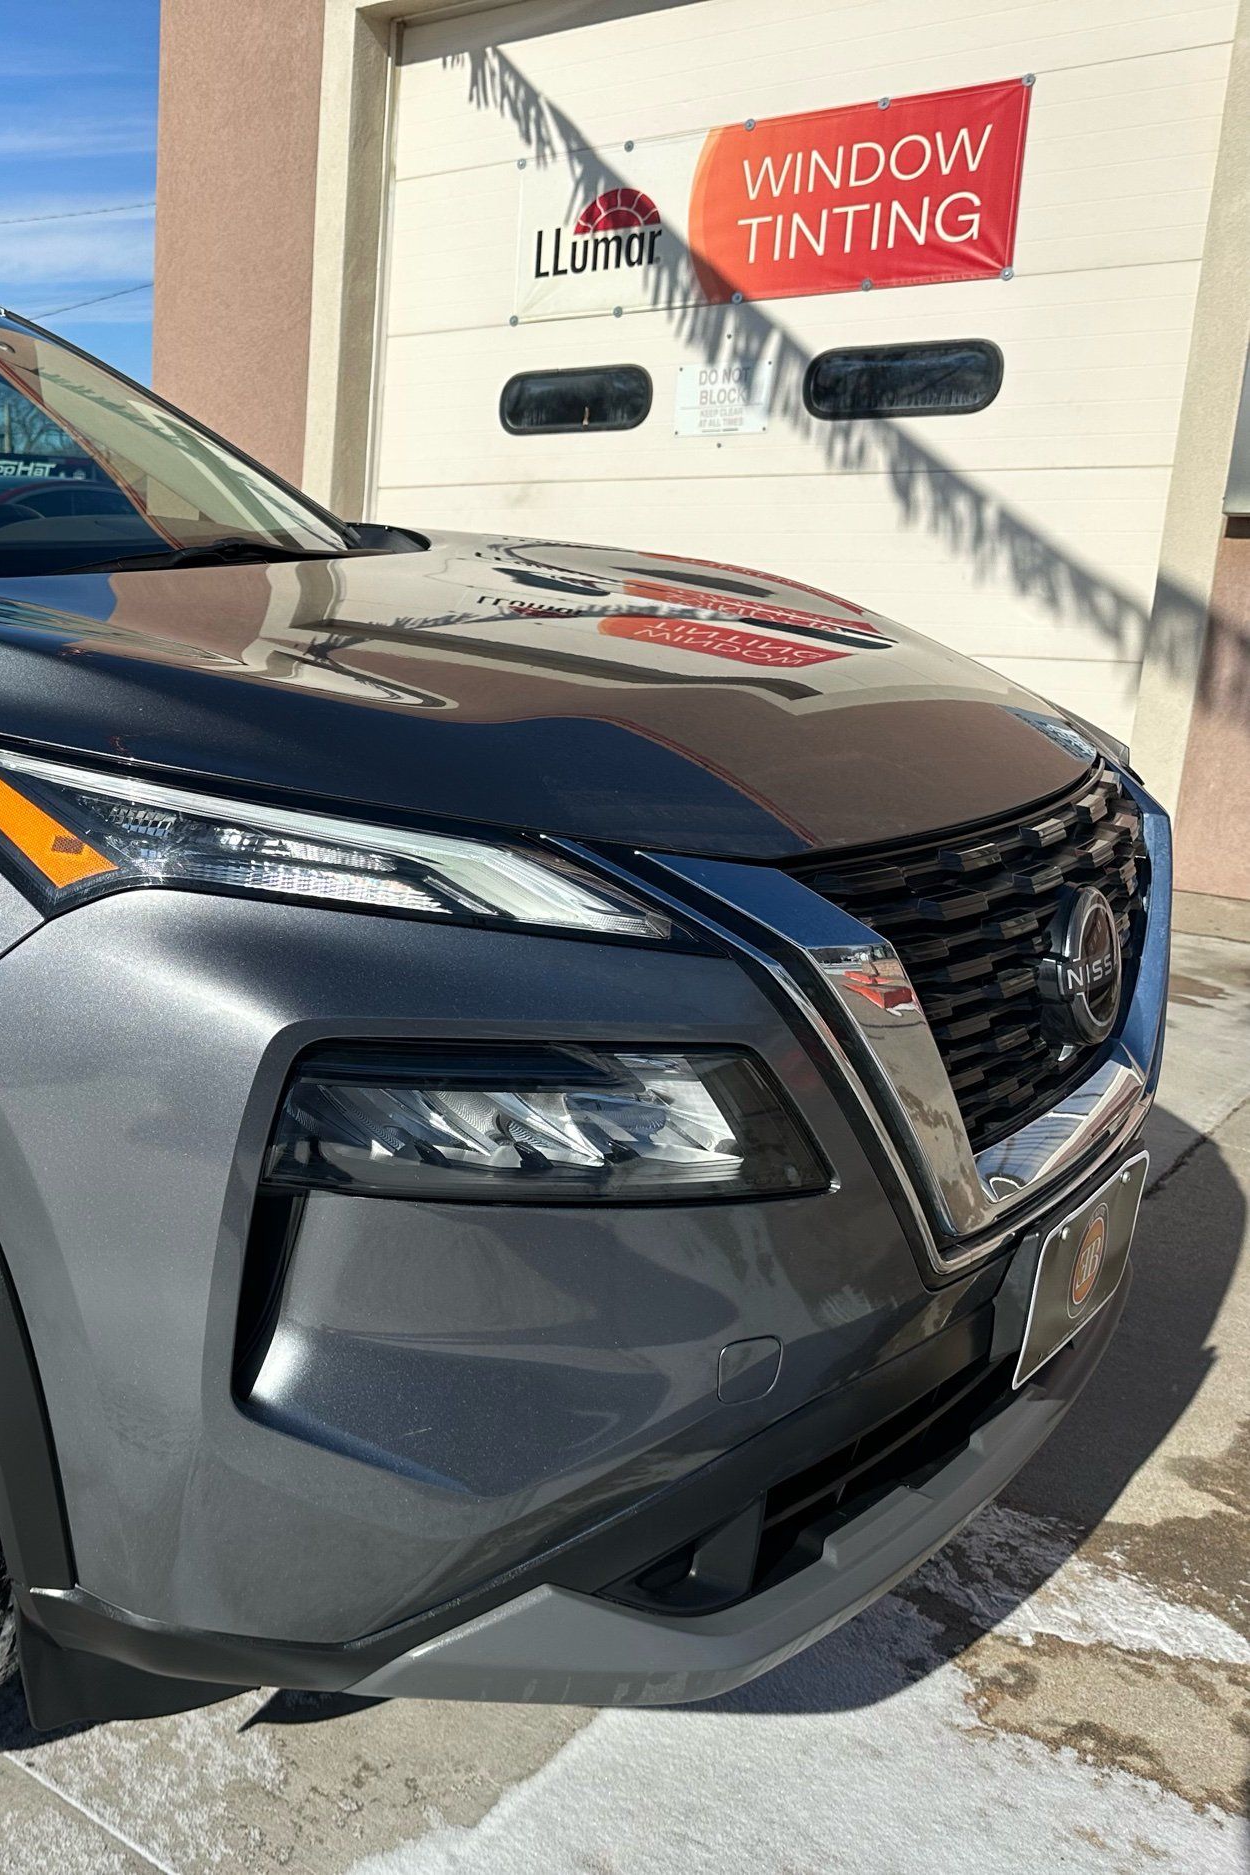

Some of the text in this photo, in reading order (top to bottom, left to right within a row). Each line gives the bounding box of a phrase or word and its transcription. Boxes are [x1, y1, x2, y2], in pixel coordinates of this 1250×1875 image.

[743, 123, 993, 201] WINDOW
[737, 191, 982, 264] TINTING
[534, 224, 661, 278] LLumar
[698, 367, 750, 386] DO NOT
[699, 388, 748, 405] BLOCK
[1066, 953, 1113, 990] NISS
